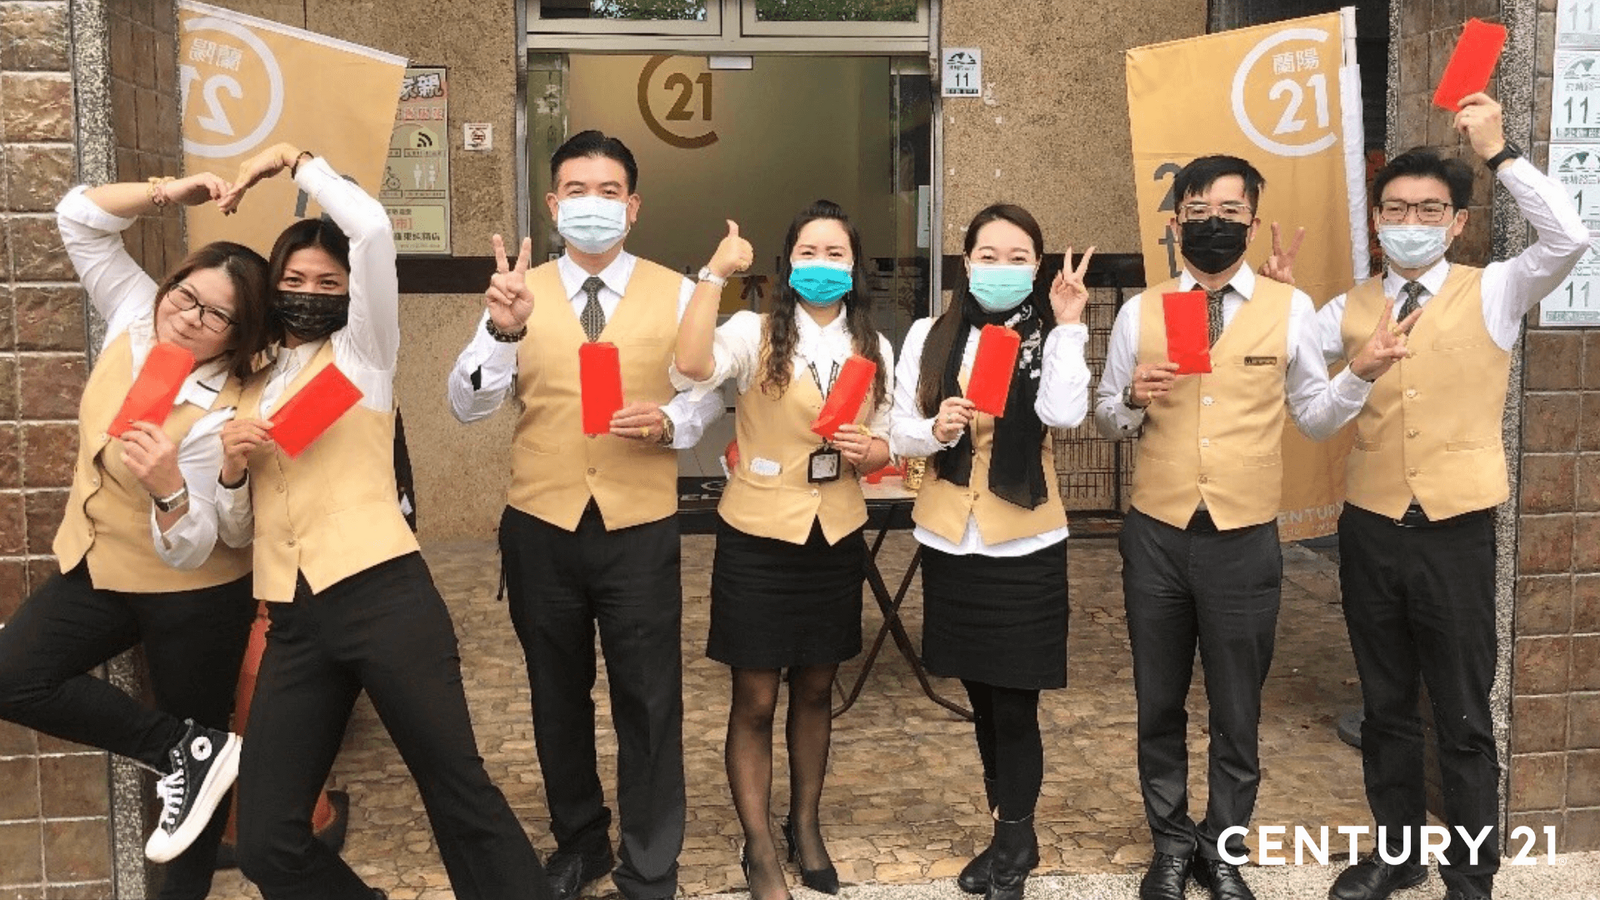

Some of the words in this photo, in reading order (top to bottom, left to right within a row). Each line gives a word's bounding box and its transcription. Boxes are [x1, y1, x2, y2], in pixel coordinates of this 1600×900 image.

[663, 72, 713, 121] 21
[955, 72, 969, 87] 11
[1268, 73, 1330, 136] 21
[1565, 280, 1591, 308] 11
